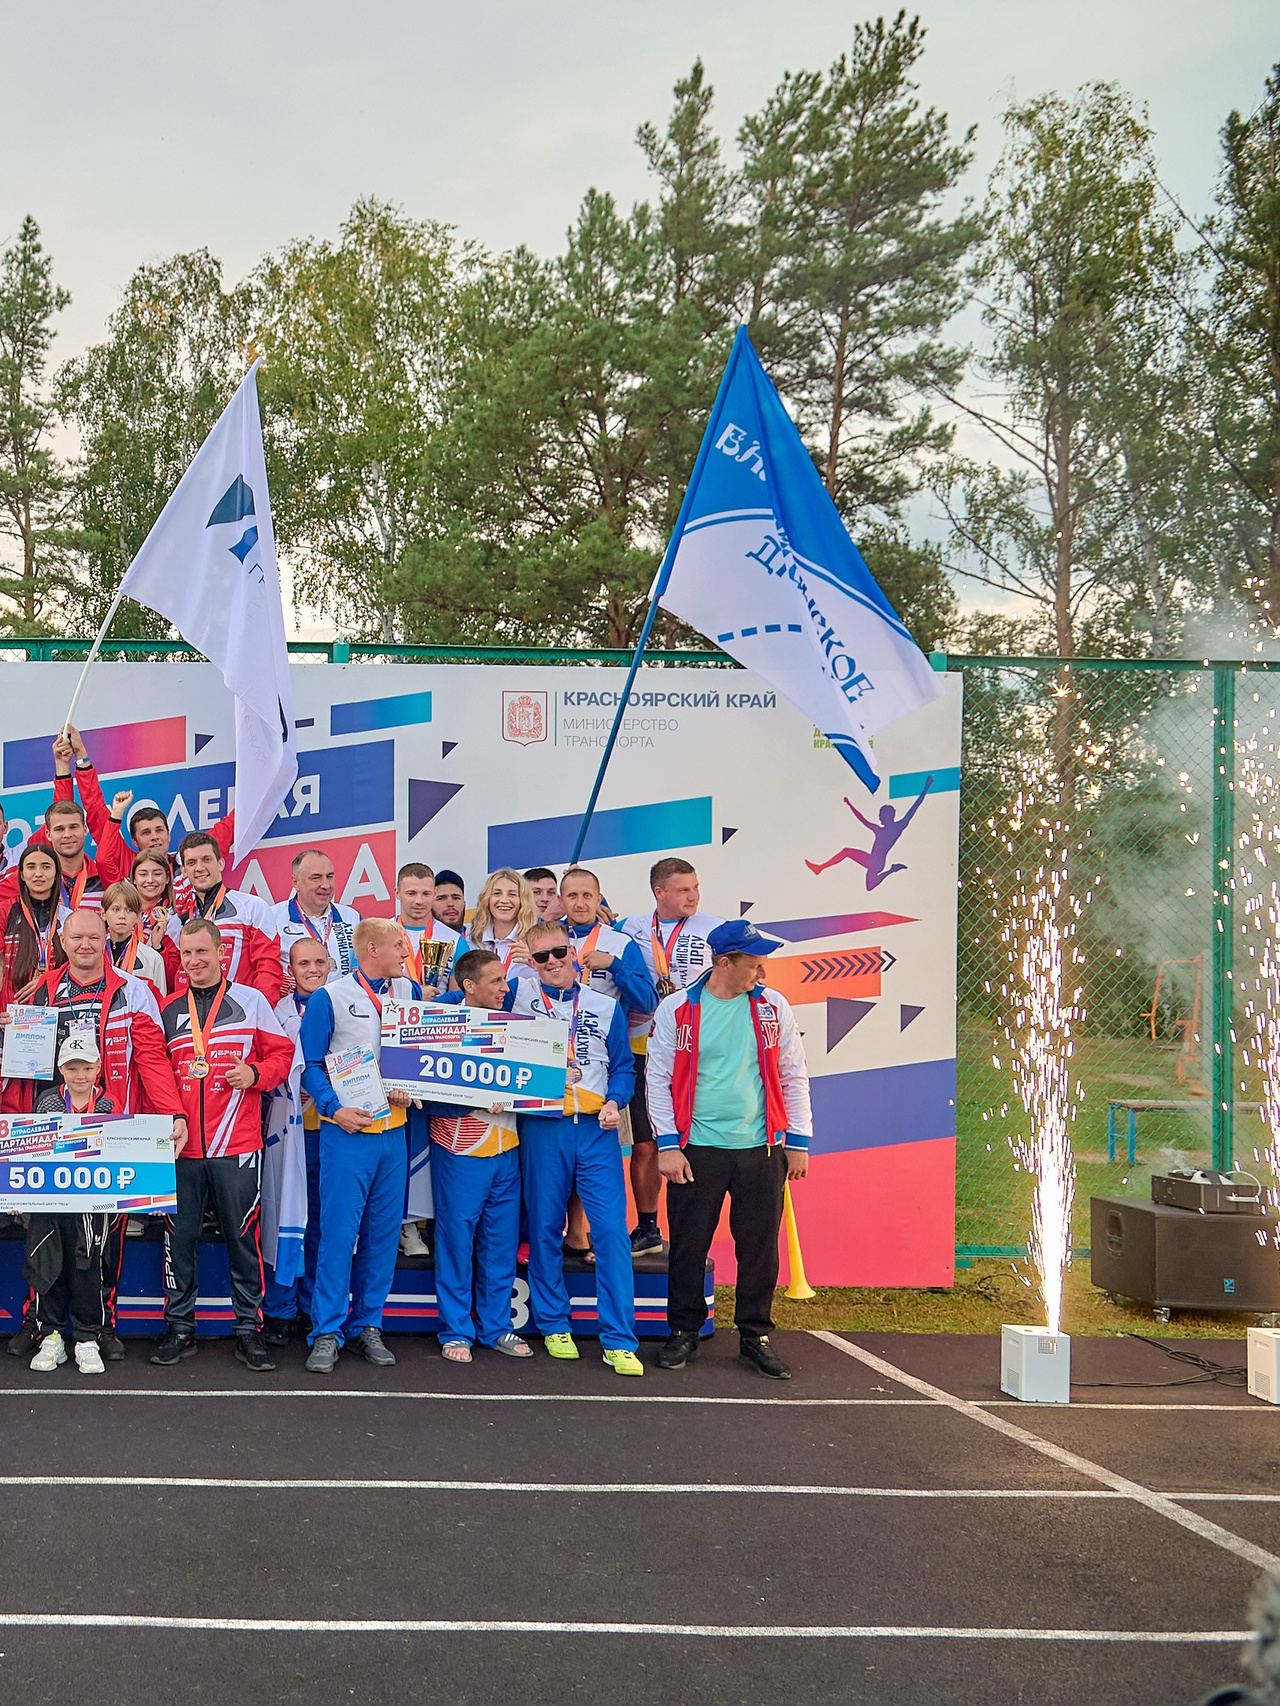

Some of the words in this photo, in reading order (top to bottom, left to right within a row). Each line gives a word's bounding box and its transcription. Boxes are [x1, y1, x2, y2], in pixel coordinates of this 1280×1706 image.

[563, 690, 720, 708] КРАСНОЯРСКИЙ
[726, 690, 777, 709] КРАЙ
[563, 717, 679, 731] МИНИСЕРСТВО
[690, 934, 705, 967] ДРСУ
[398, 1006, 420, 1026] 18
[422, 1016, 459, 1024] ОТРАСЛЕВАЯ
[15, 1032, 46, 1041] ДИПЛОМ
[401, 1025, 466, 1036] СПАРТАКИАДА
[332, 1055, 343, 1067] 18
[418, 1055, 453, 1079] 20
[342, 1073, 371, 1087] ДИПЛОМ
[11, 1125, 50, 1136] ОТРАСЛЕВАЯ
[8, 1166, 45, 1189] 50
[164, 1230, 177, 1290] БРИЗ
